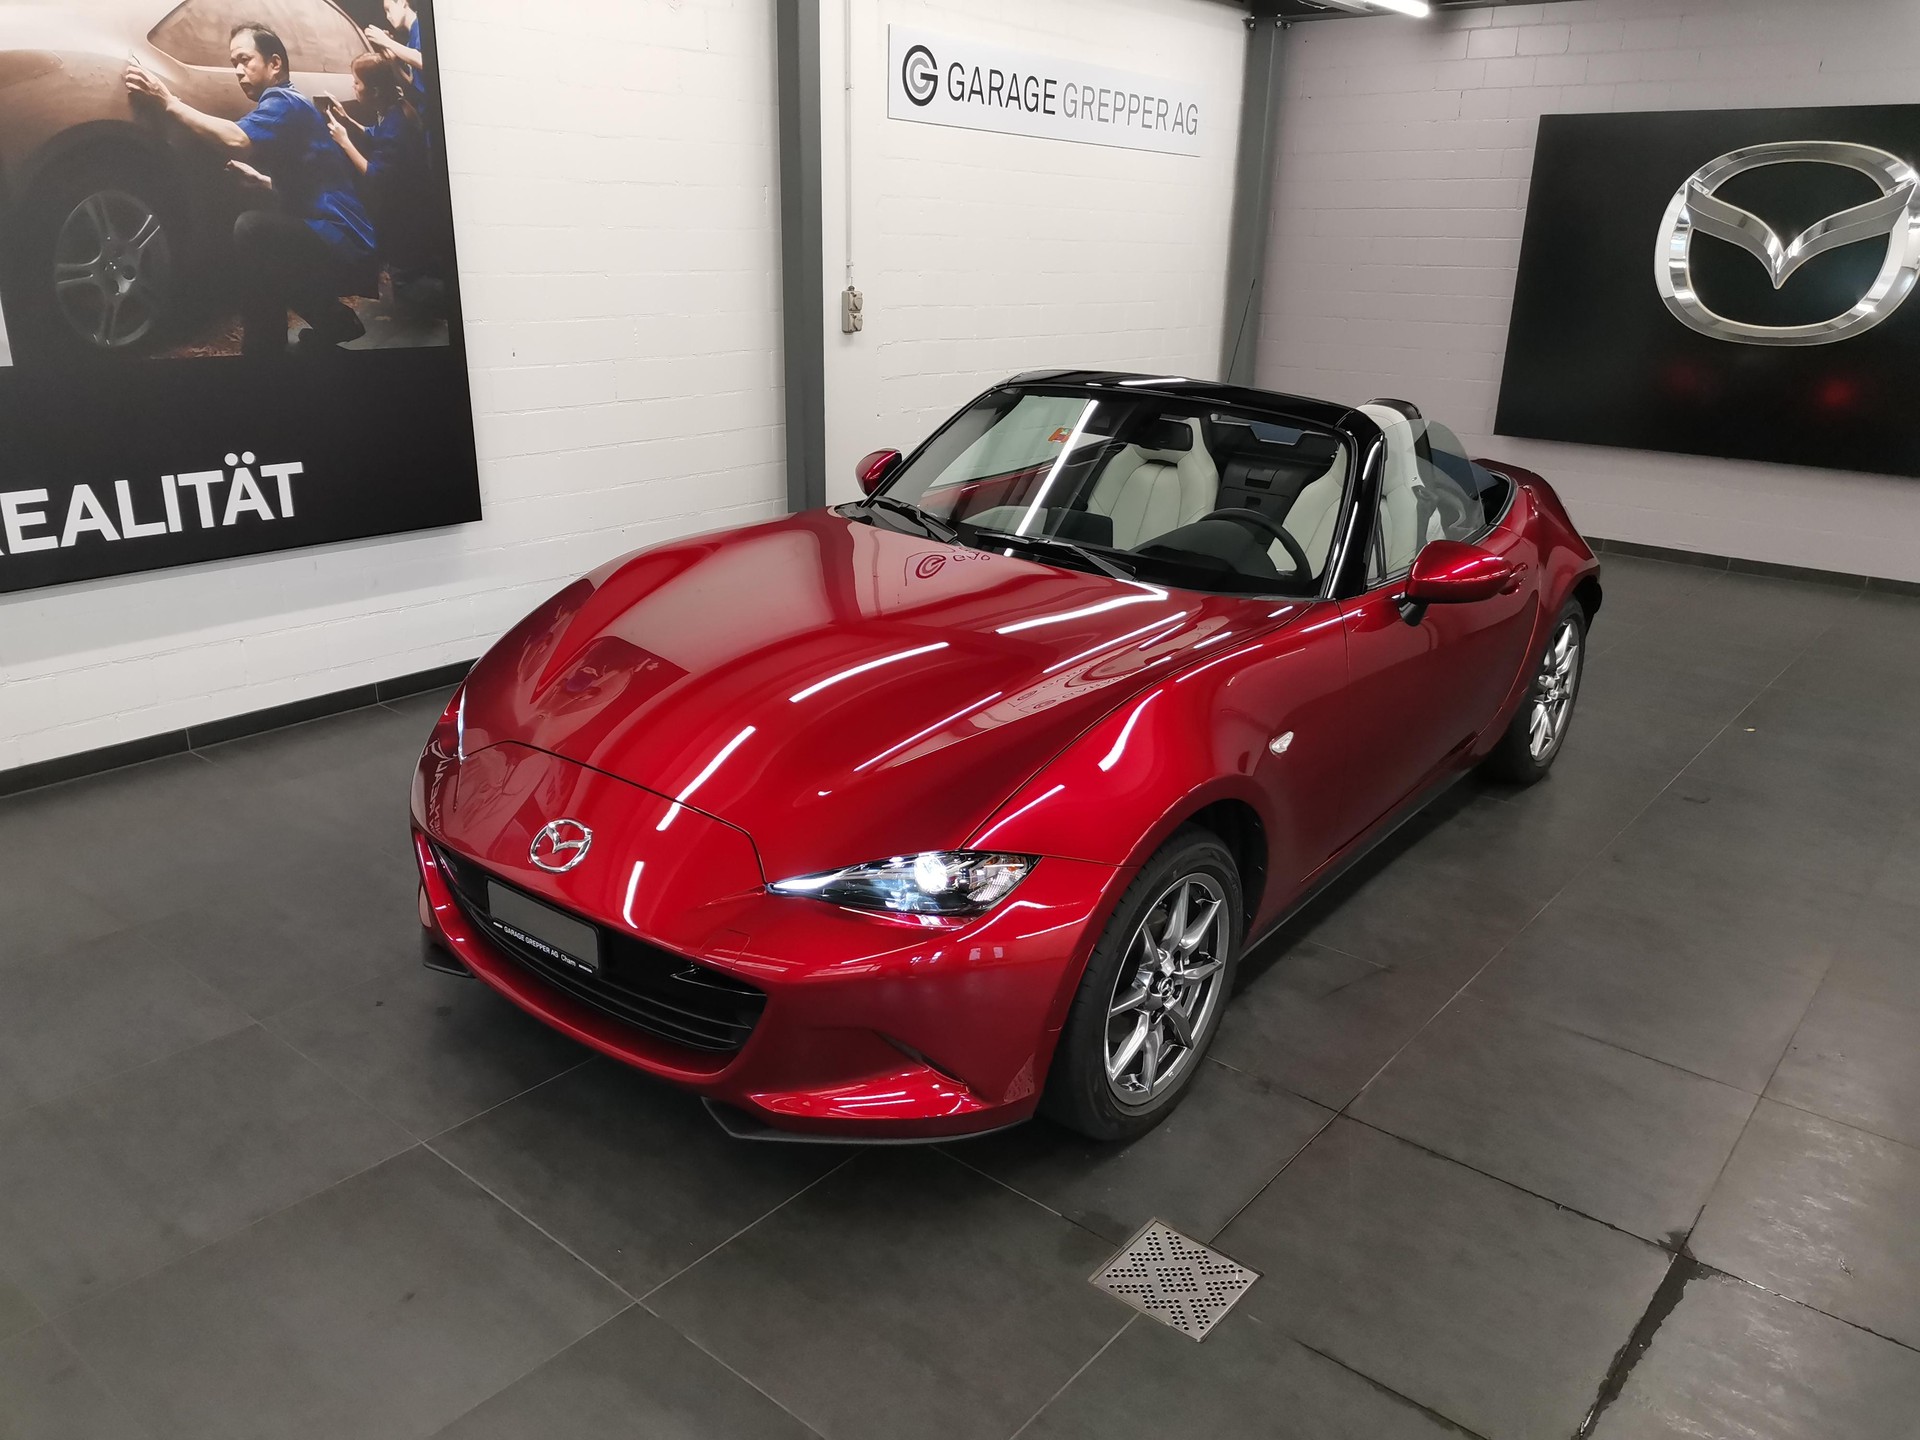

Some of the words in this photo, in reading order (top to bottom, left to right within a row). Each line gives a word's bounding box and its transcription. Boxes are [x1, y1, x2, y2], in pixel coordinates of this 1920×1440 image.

[948, 61, 1058, 115] GARAGE
[1062, 82, 1169, 131] GREPPER
[1171, 101, 1199, 136] AG
[0, 451, 303, 556] EALITÄT
[504, 926, 525, 941] GARAGE
[525, 937, 551, 954] GREPPER
[551, 949, 559, 958] AG
